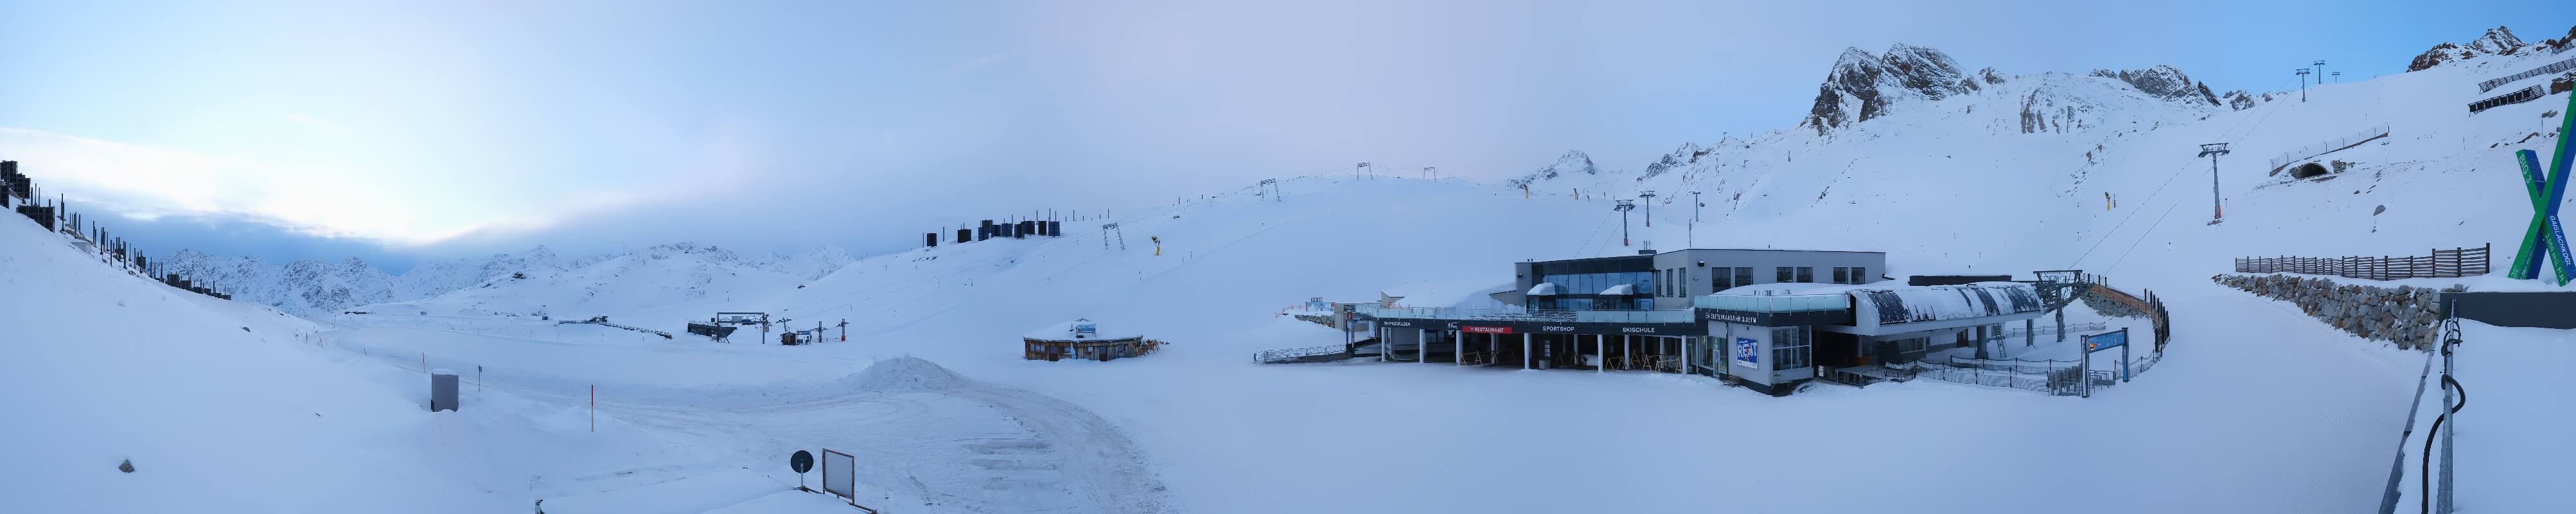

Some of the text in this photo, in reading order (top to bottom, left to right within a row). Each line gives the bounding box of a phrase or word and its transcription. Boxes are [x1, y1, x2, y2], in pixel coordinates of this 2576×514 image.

[2519, 154, 2532, 184] BIG 3
[2550, 215, 2572, 267] GAISLACHKOGL
